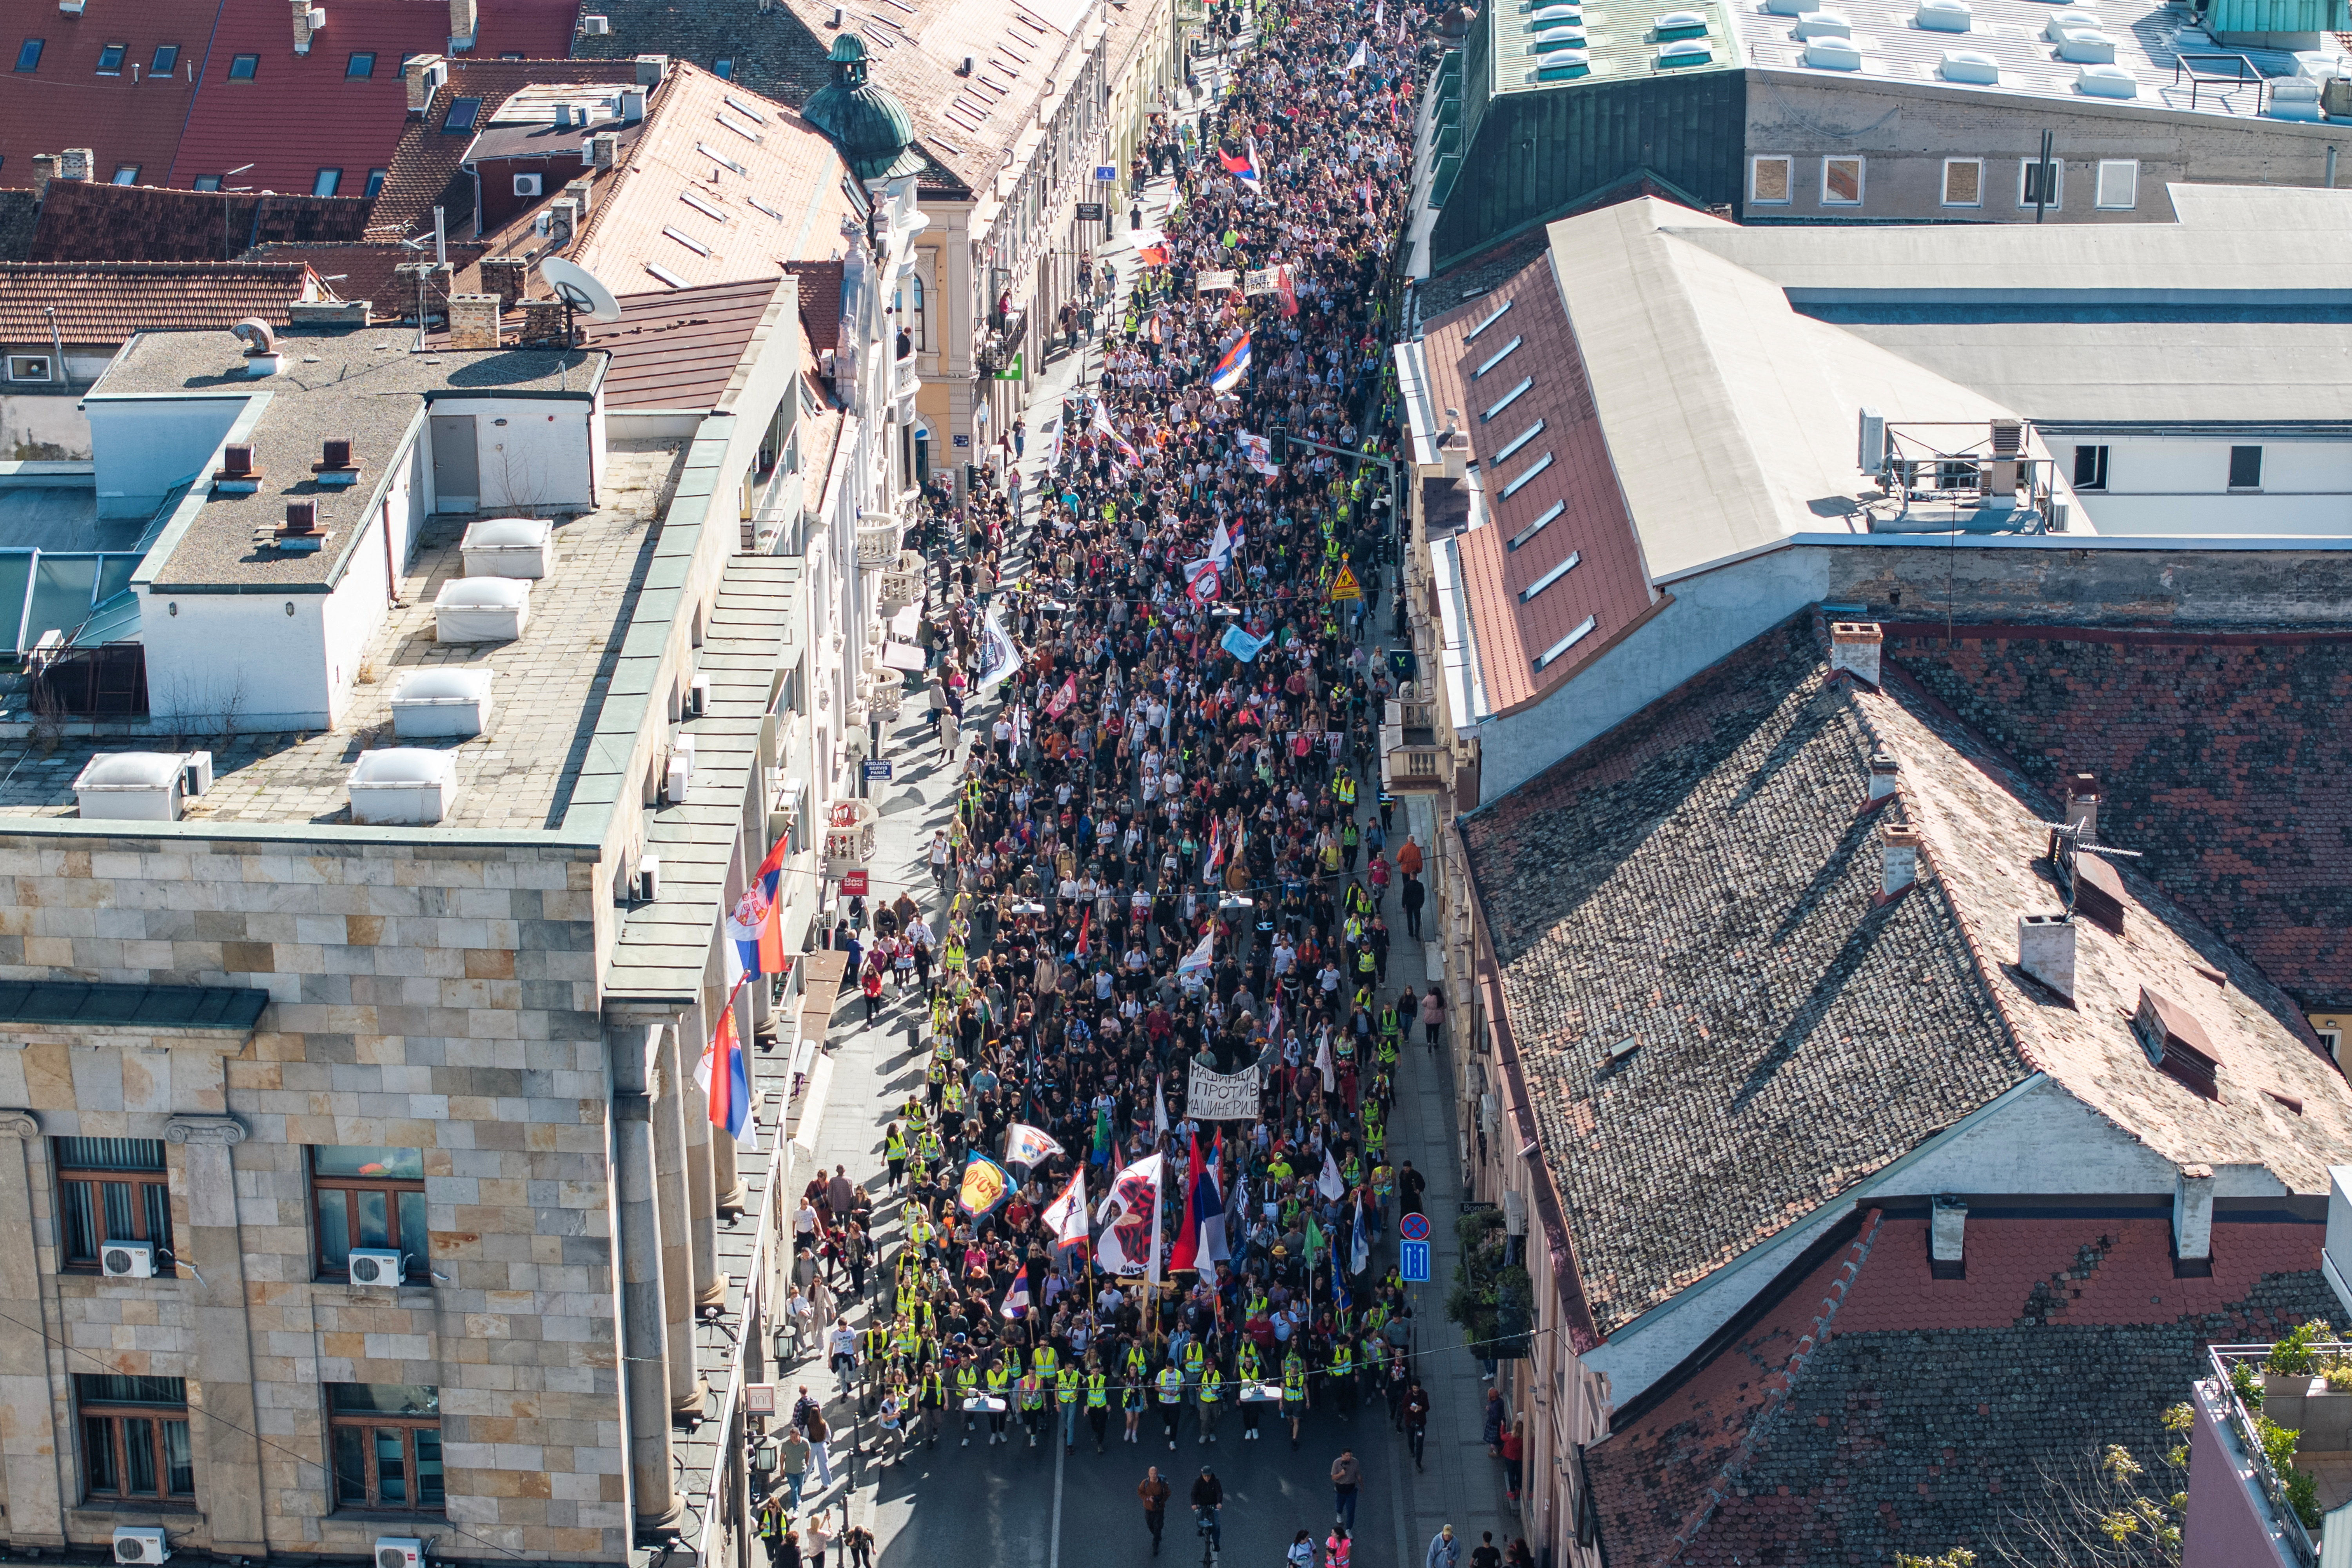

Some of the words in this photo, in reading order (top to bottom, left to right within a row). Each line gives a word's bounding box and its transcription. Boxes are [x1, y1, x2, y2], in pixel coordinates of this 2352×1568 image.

[844, 878, 863, 886] Boa
[1191, 1065, 1255, 1084] МАШИНЦИ
[1195, 1082, 1258, 1099] ПРОТИВ
[1188, 1099, 1259, 1116] МАШИНЕРИЈЕ
